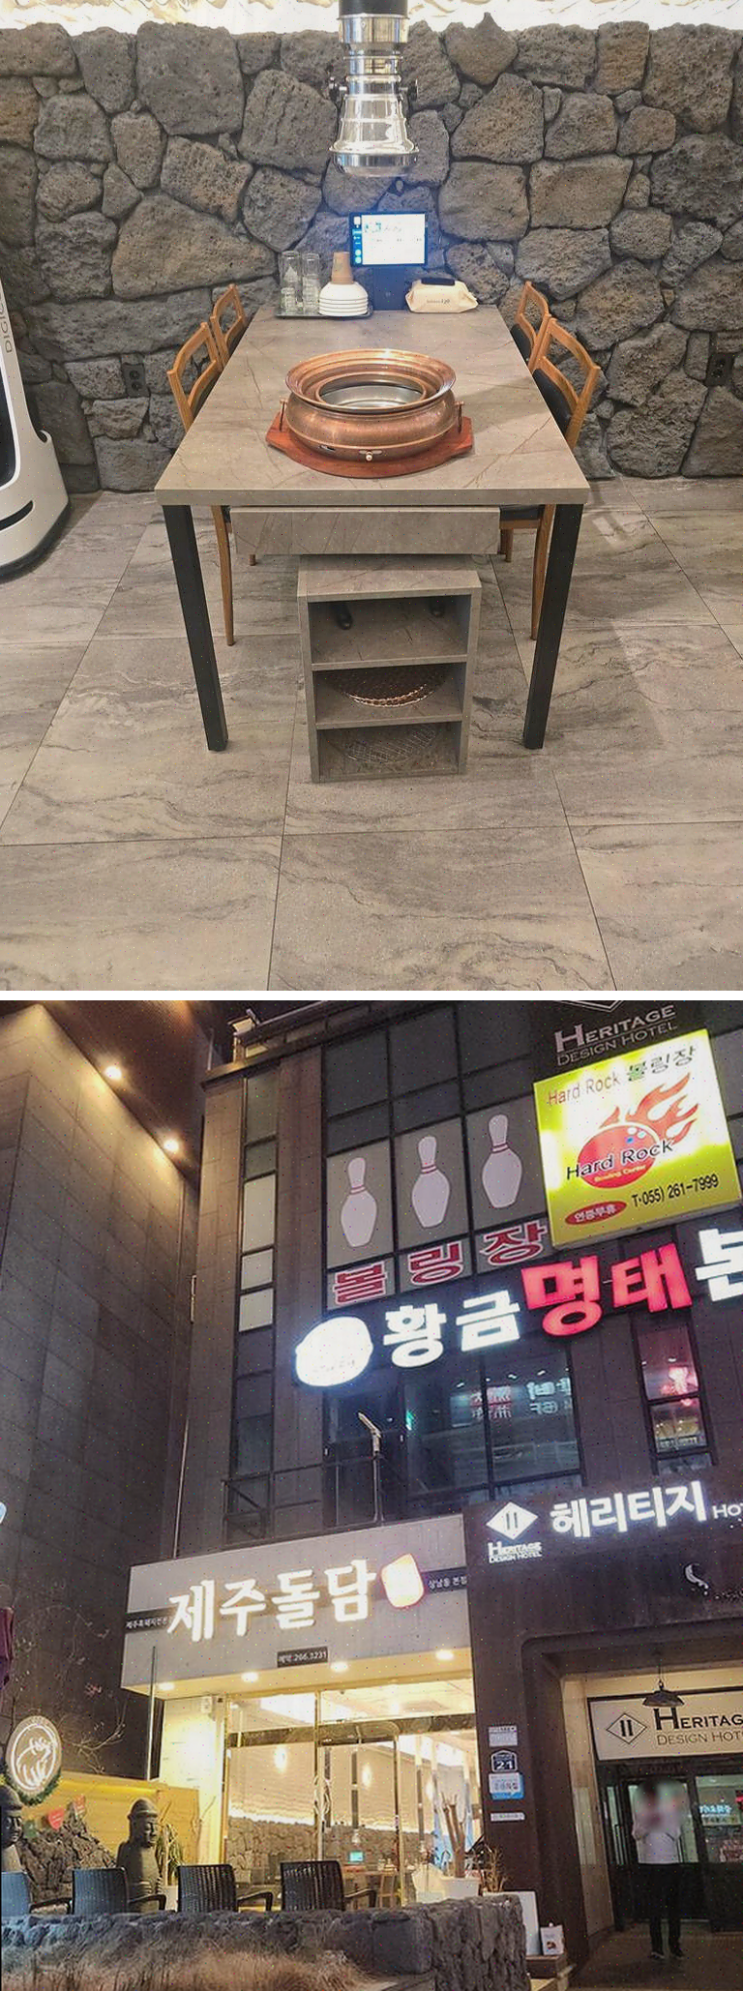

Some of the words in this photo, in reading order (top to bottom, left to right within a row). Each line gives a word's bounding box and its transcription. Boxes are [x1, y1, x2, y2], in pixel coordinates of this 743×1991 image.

[554, 1005, 676, 1052] HERITAGE
[556, 1041, 617, 1067] DESIGN
[621, 1022, 678, 1046] HOTEL
[548, 1082, 581, 1106] Hard
[586, 1072, 621, 1095] Rock
[626, 1045, 696, 1082] 볼링장
[566, 1153, 614, 1180] Hard
[621, 1140, 674, 1165] Rock
[667, 1173, 720, 1200] 261-7999
[332, 1219, 548, 1305] 볼링장
[550, 1480, 707, 1538] 헤리티지
[712, 1502, 743, 1519] HO
[167, 1559, 377, 1643] 제주돌담
[656, 1730, 708, 1746] DESIGN
[711, 1729, 743, 1742] HOT
